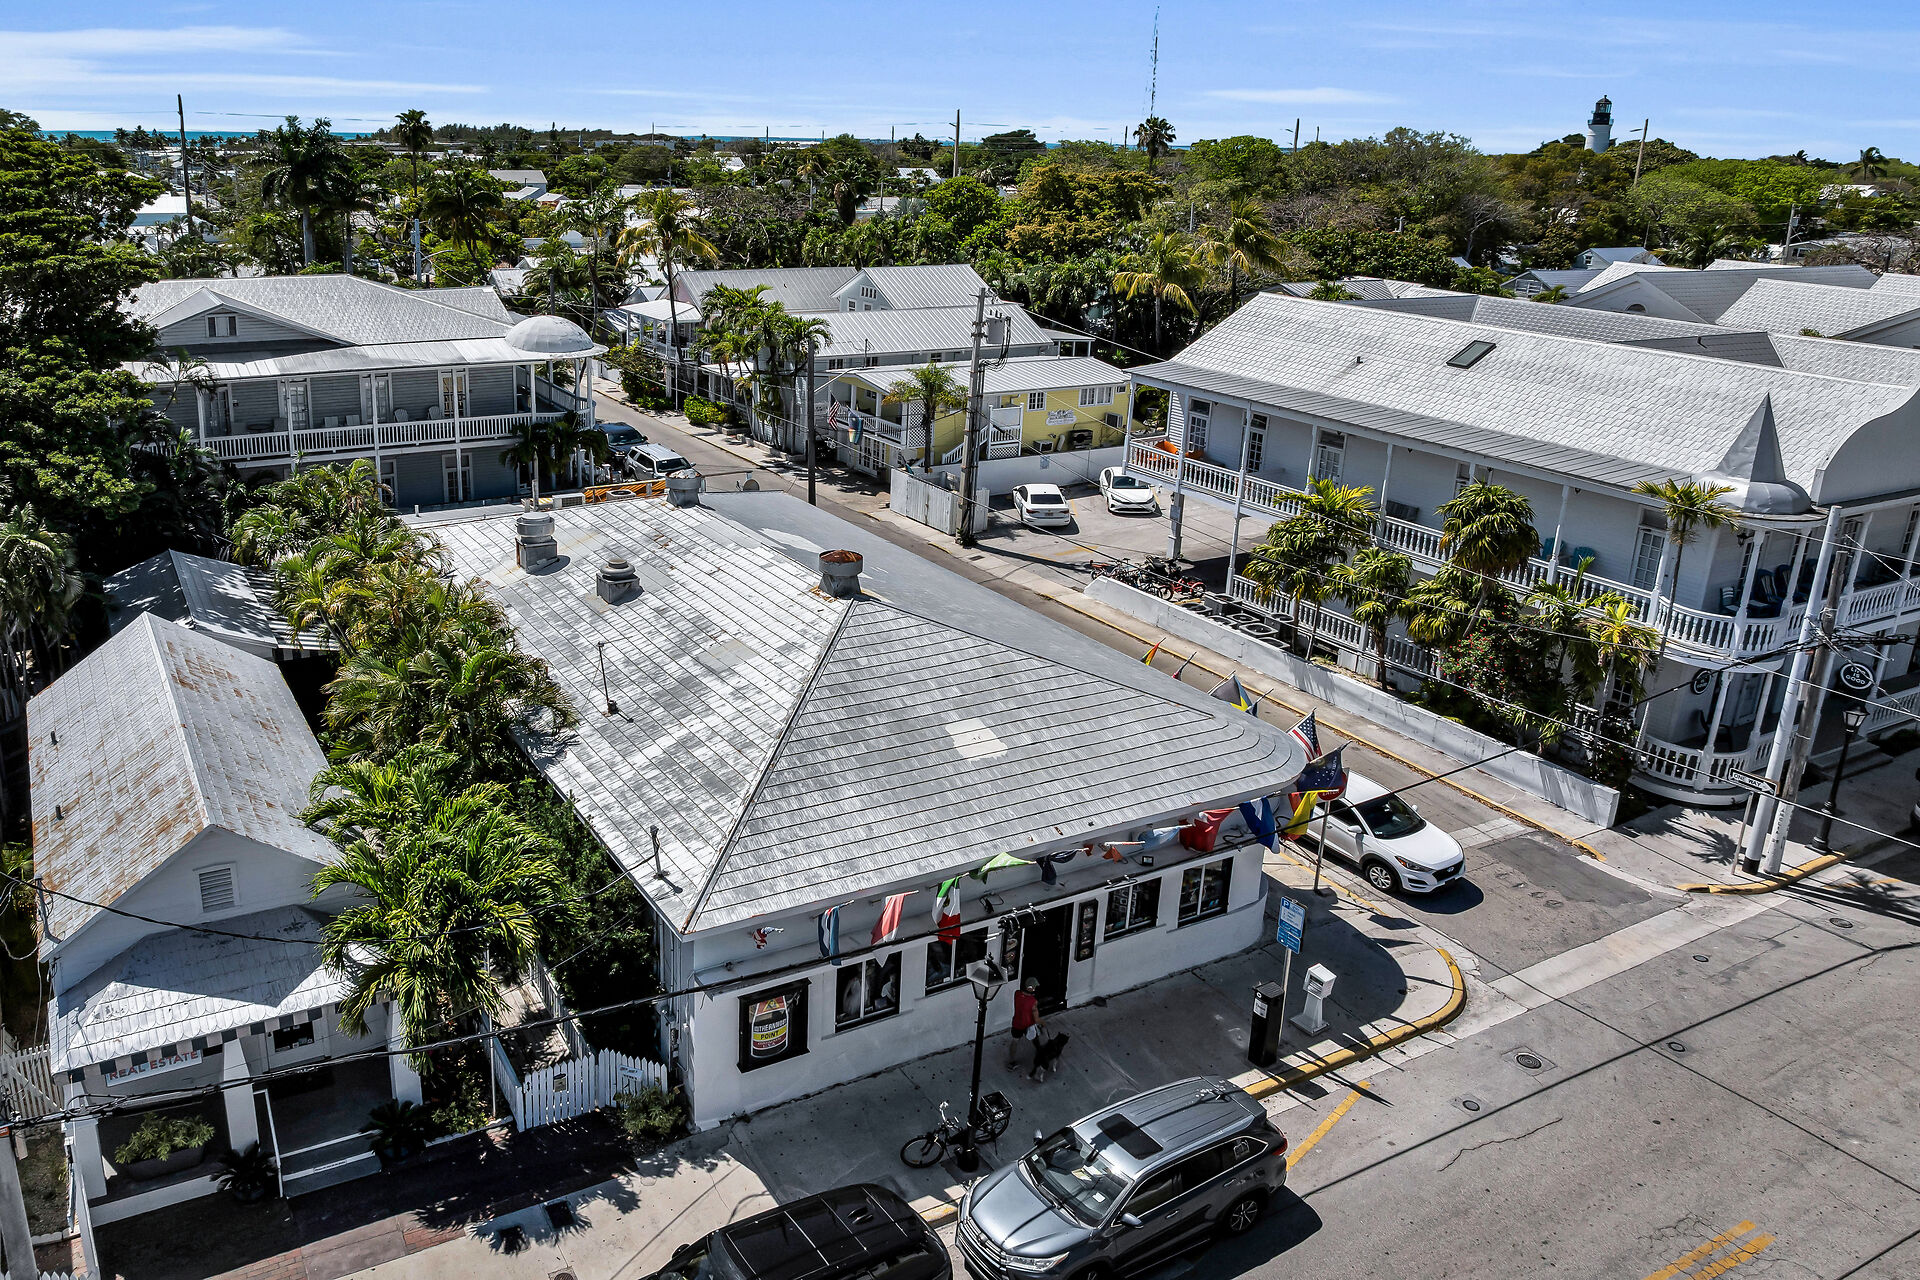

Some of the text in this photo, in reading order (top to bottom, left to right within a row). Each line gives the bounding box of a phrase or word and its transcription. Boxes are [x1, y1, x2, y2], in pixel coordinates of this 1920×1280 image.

[1845, 674, 1866, 685] GOOD
[1733, 773, 1762, 787] ONE WAY
[760, 1031, 779, 1040] POINT
[109, 1050, 199, 1081] REAL ESTATE
